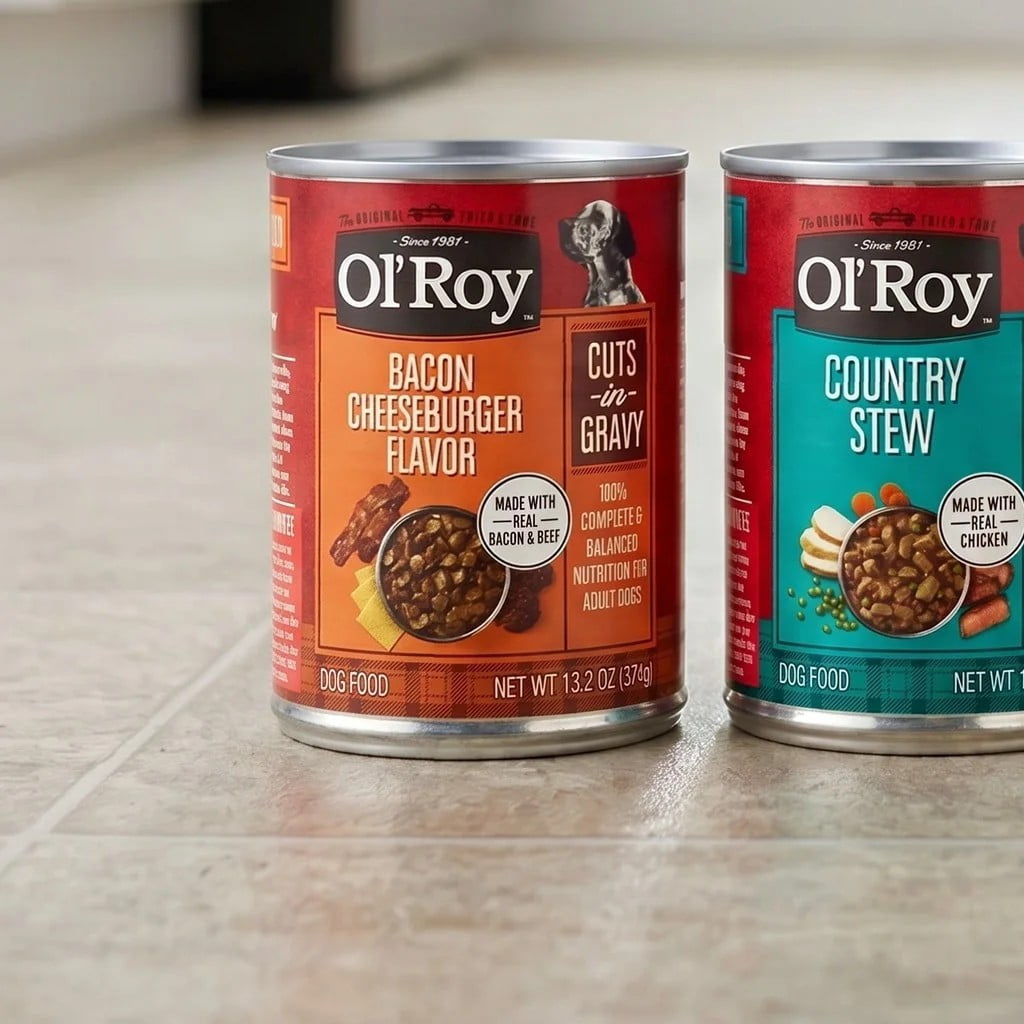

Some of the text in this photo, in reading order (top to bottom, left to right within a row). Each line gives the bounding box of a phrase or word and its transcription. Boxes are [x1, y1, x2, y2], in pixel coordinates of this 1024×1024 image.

[399, 235, 463, 247] Since 1981
[860, 239, 924, 251] Since 1981
[388, 352, 474, 393] BACON
[588, 340, 637, 380] CUTS
[825, 354, 965, 403] COUNTRY
[347, 392, 523, 433] CHEESEBURGER
[580, 410, 645, 454] GRAVY
[850, 407, 934, 455] STEW
[386, 435, 477, 476] FLAVOR
[495, 494, 556, 512] MADE WITH
[599, 482, 627, 502] 100%
[952, 495, 1016, 513] MADE WITH
[513, 514, 538, 529] REAL
[581, 506, 635, 531] COMPLETE
[971, 515, 998, 530] REAL
[489, 529, 561, 546] BACON & BEEF
[586, 533, 638, 558] BALANCED
[960, 531, 1008, 548] CHICKEN
[573, 561, 630, 586] NUTRITION
[583, 585, 643, 612] ADULT DOGS
[320, 667, 346, 693] DOG
[349, 671, 389, 697] FOOD
[494, 676, 525, 699] NET
[531, 674, 557, 697] WT
[562, 670, 593, 694] 13.2
[597, 667, 616, 691] OZ
[778, 662, 850, 691] DOG FOOD
[954, 671, 985, 694] NET
[990, 668, 1015, 692] WT
